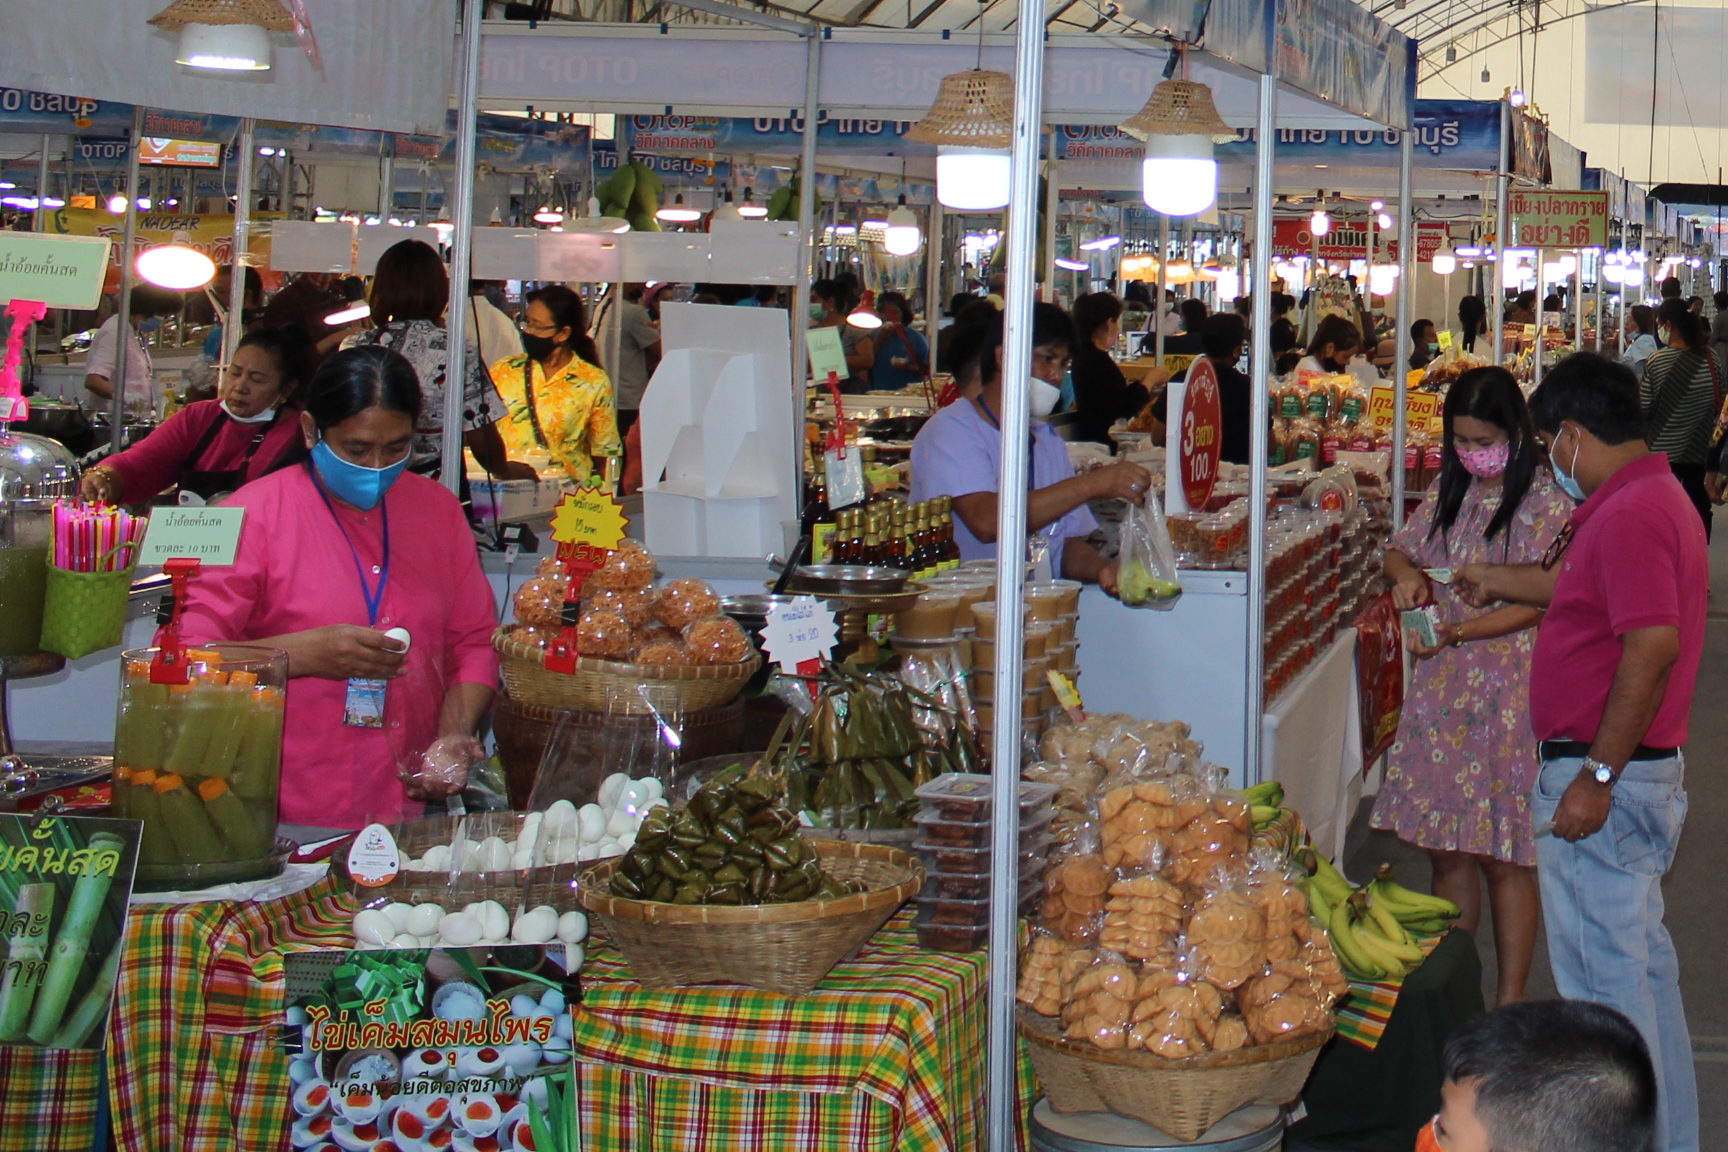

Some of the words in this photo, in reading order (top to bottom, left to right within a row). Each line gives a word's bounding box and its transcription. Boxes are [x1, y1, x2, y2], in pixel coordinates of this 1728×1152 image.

[635, 132, 716, 149] วิถีภาคกลาง
[1066, 141, 1147, 159] วิถีภาคกลา
[81, 144, 126, 159] OTOP
[1521, 218, 1590, 244] อย่างดี
[1184, 411, 1195, 456] 3
[188, 545, 198, 553] 10
[201, 544, 220, 553] บาท
[559, 539, 607, 564] NEW
[306, 997, 554, 1068] ไข่เค็มสมุนไพร
